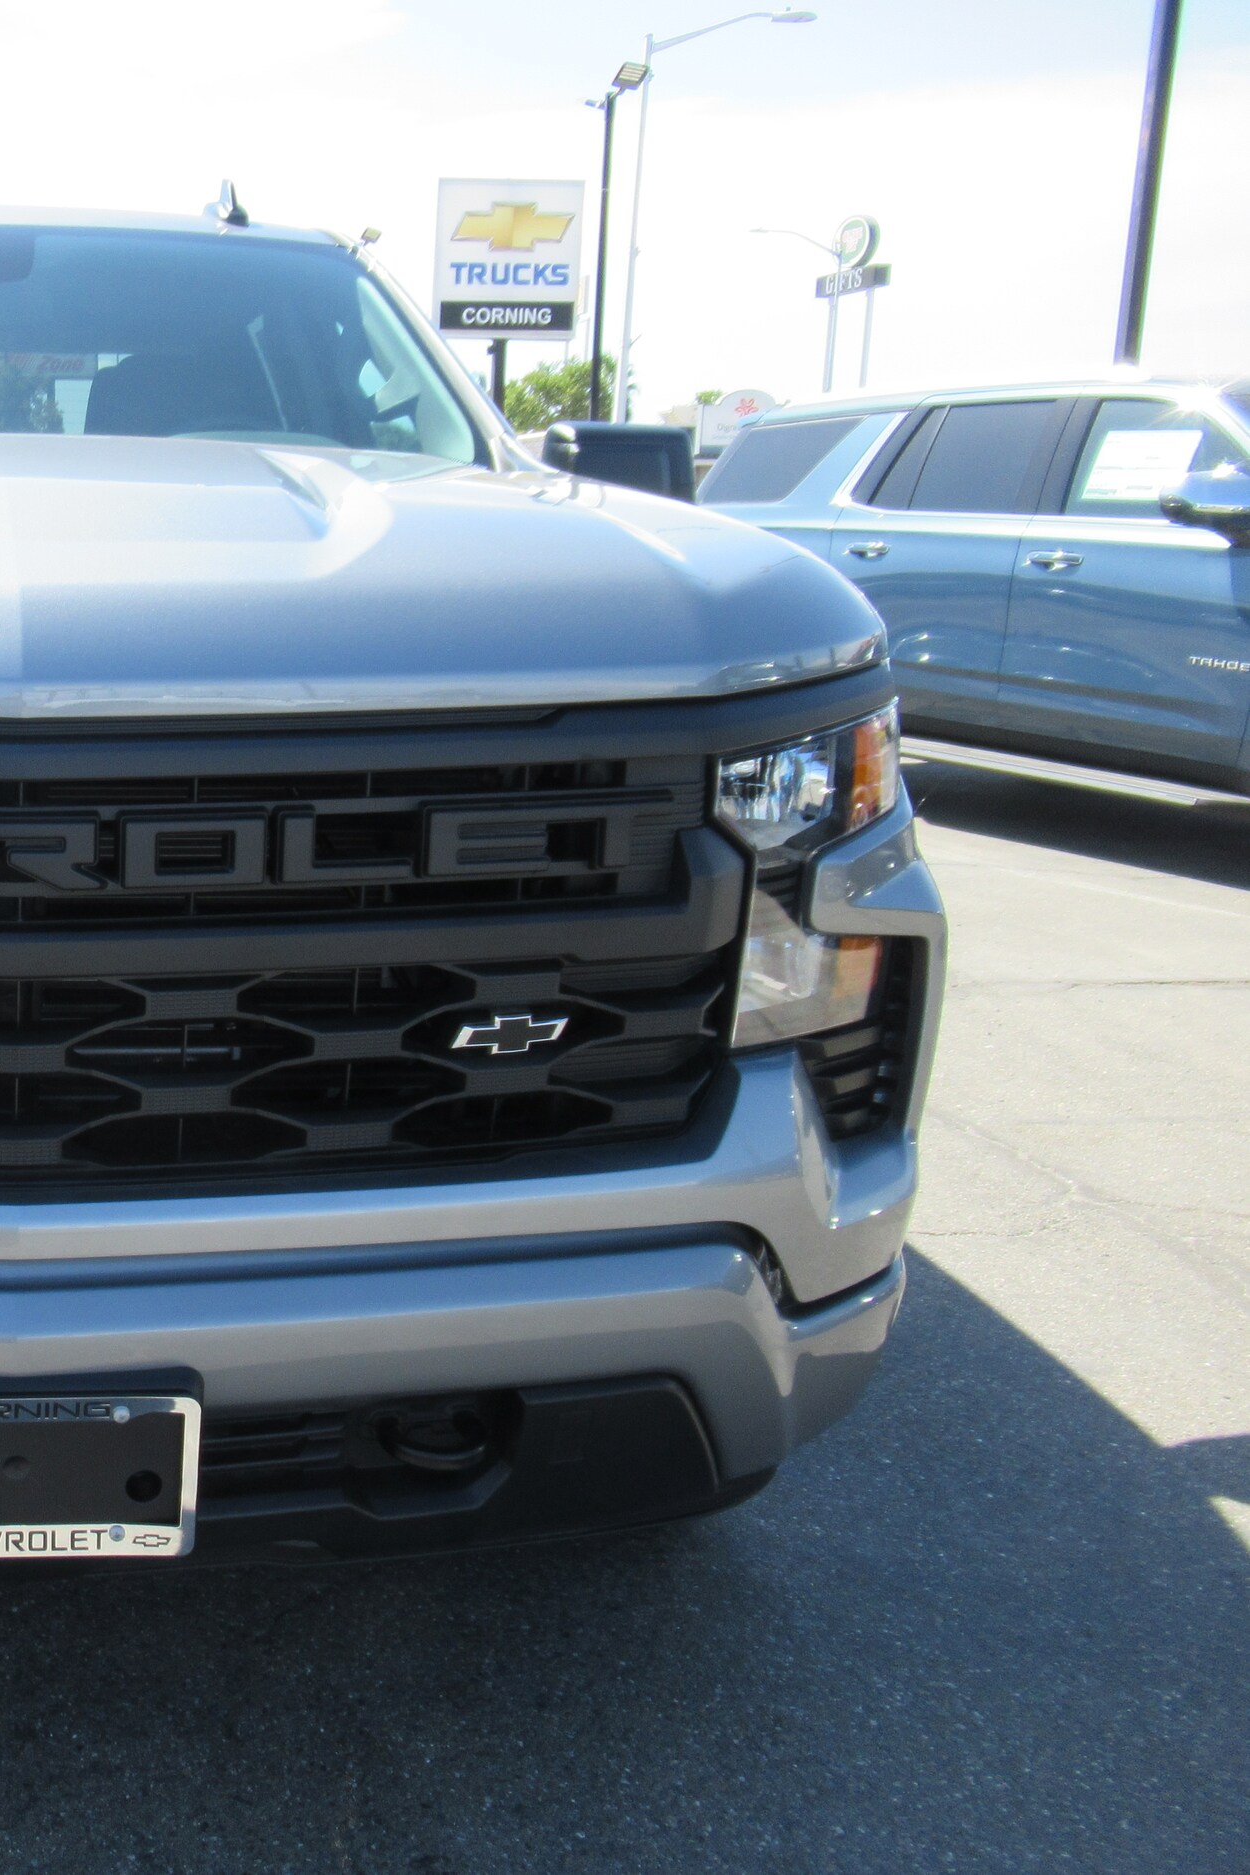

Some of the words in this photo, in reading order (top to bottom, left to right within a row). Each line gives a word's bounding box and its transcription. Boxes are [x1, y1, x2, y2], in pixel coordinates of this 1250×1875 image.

[449, 262, 570, 286] TRUCKS
[461, 306, 552, 325] CORNING
[1188, 655, 1250, 673] TAHOE
